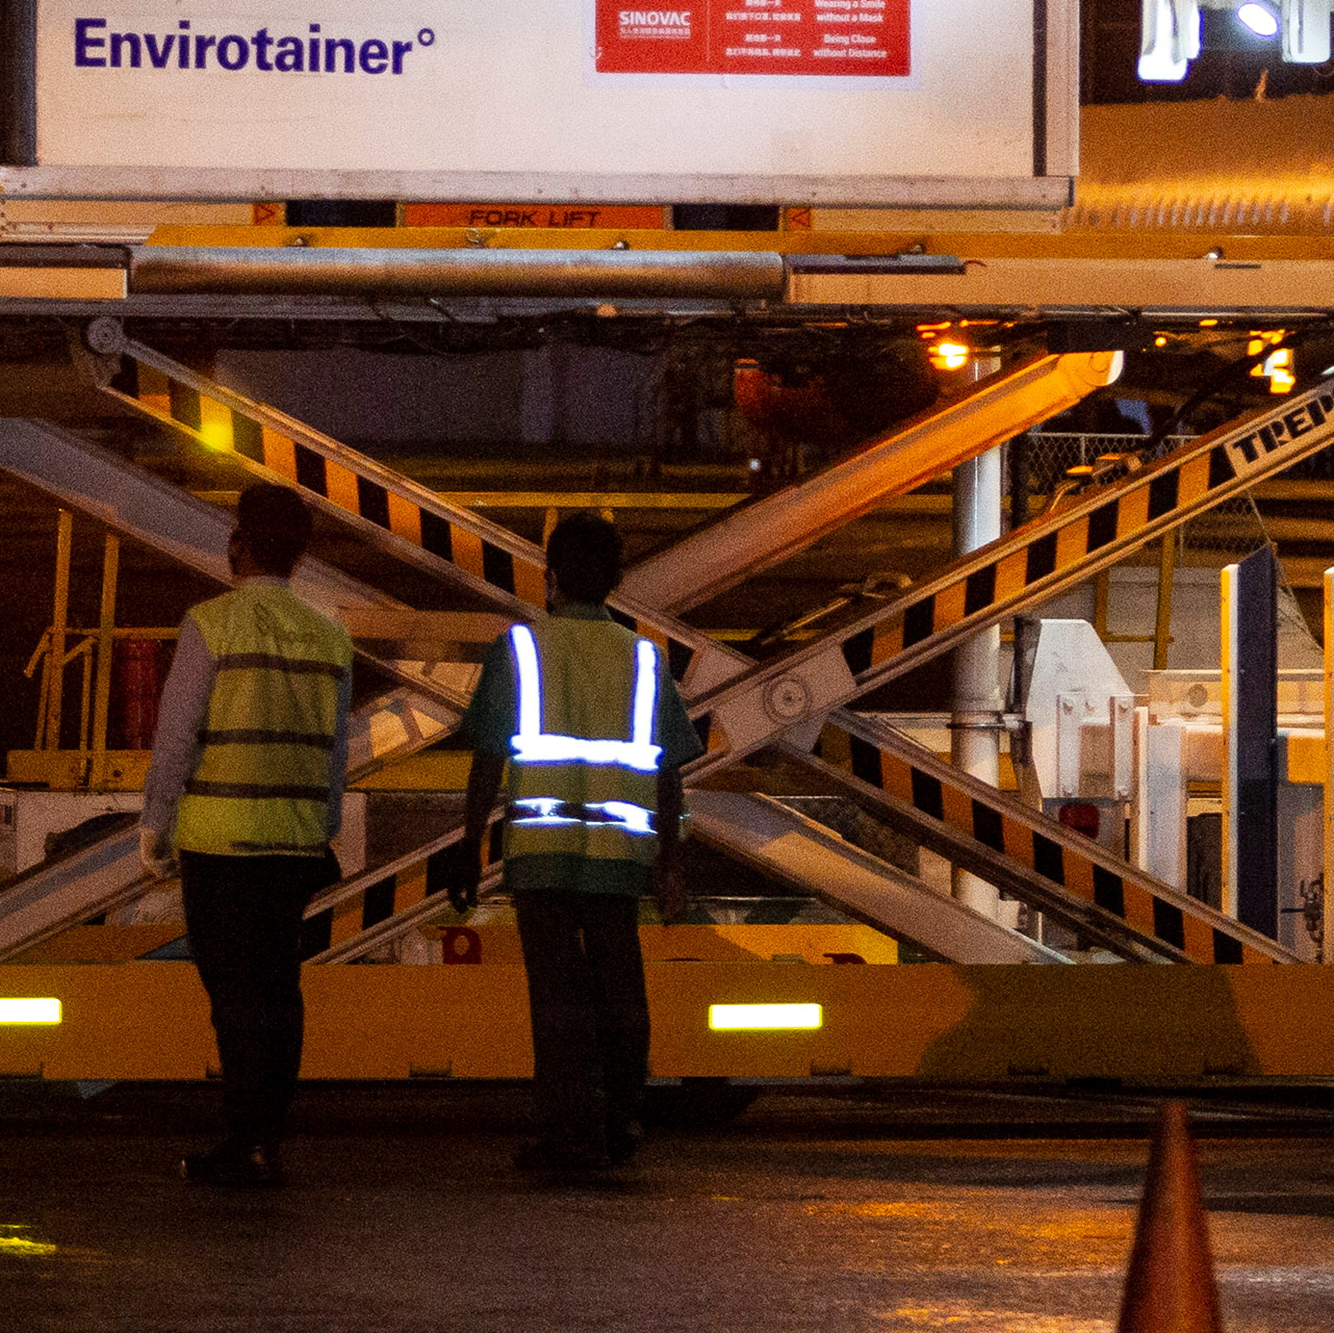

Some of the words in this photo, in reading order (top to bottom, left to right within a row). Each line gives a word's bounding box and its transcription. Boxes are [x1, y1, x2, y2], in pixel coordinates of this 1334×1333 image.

[619, 10, 691, 26] SINOVAC
[468, 210, 539, 226] FORK
[549, 210, 601, 227] LIFT
